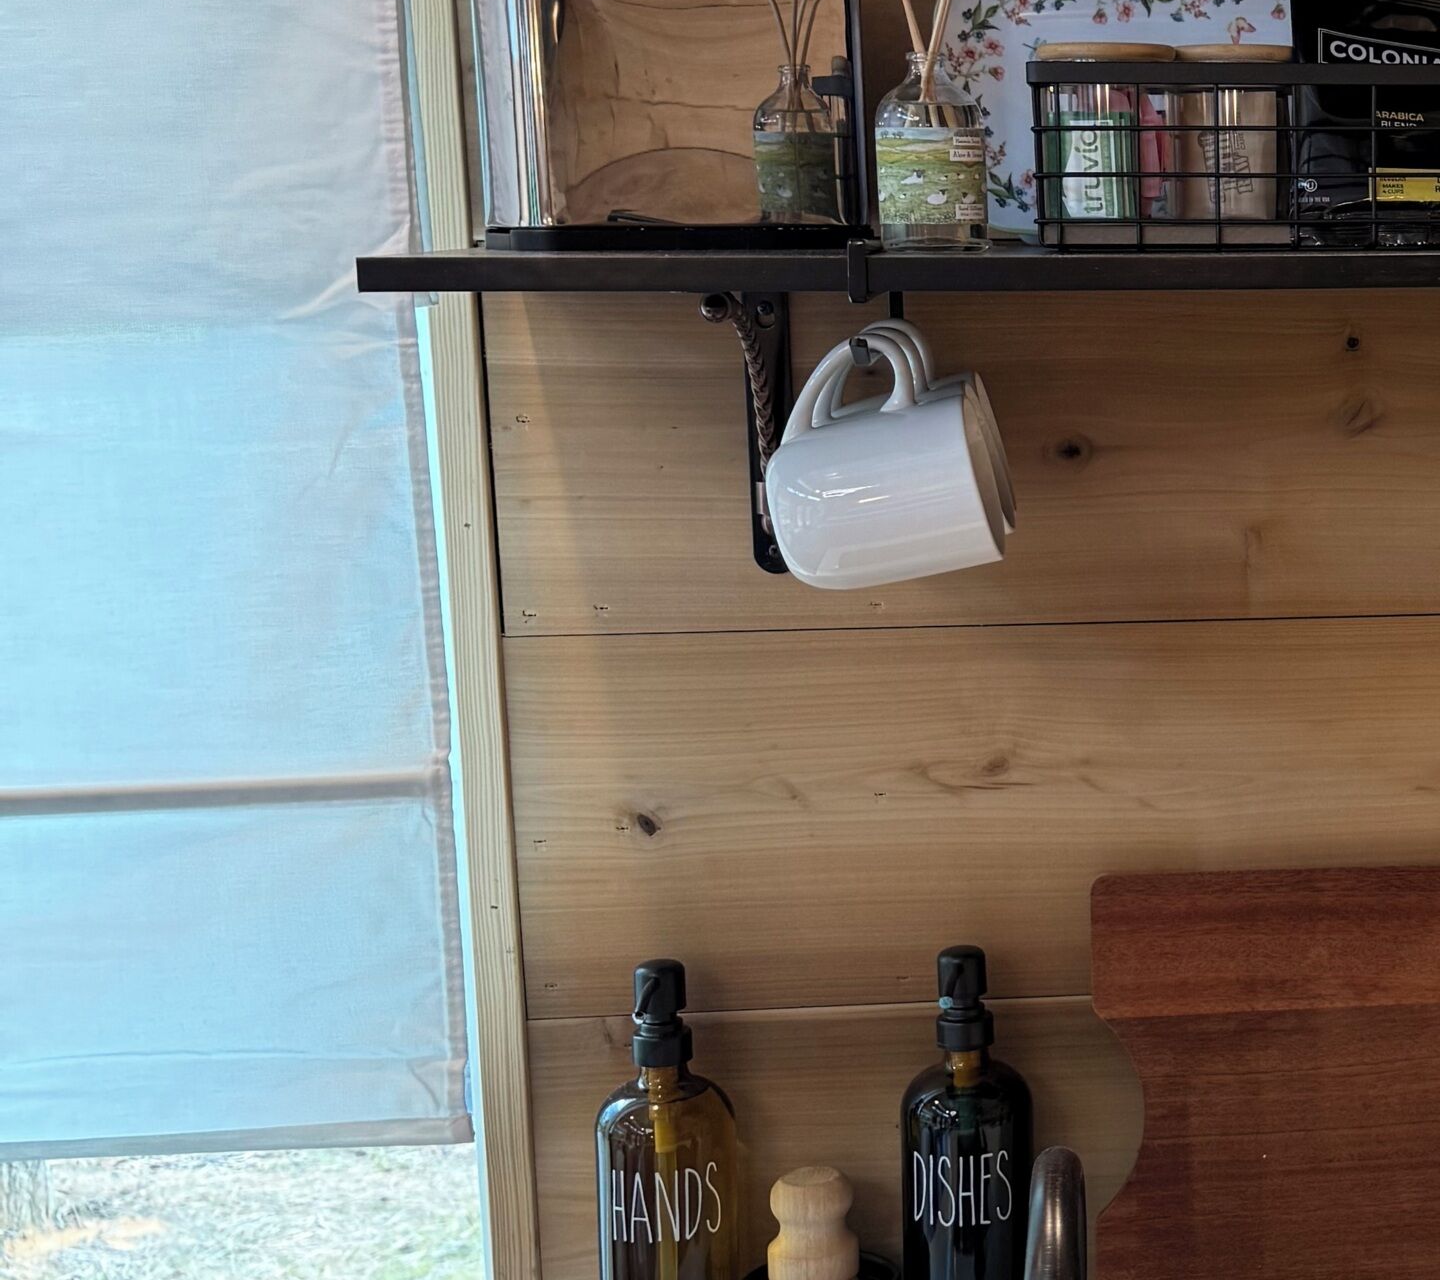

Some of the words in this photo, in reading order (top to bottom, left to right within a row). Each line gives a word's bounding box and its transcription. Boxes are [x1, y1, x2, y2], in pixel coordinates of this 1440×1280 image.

[1375, 110, 1425, 122] ARABICA
[612, 1161, 721, 1244] HANDS
[913, 1150, 1012, 1228] DISHES
